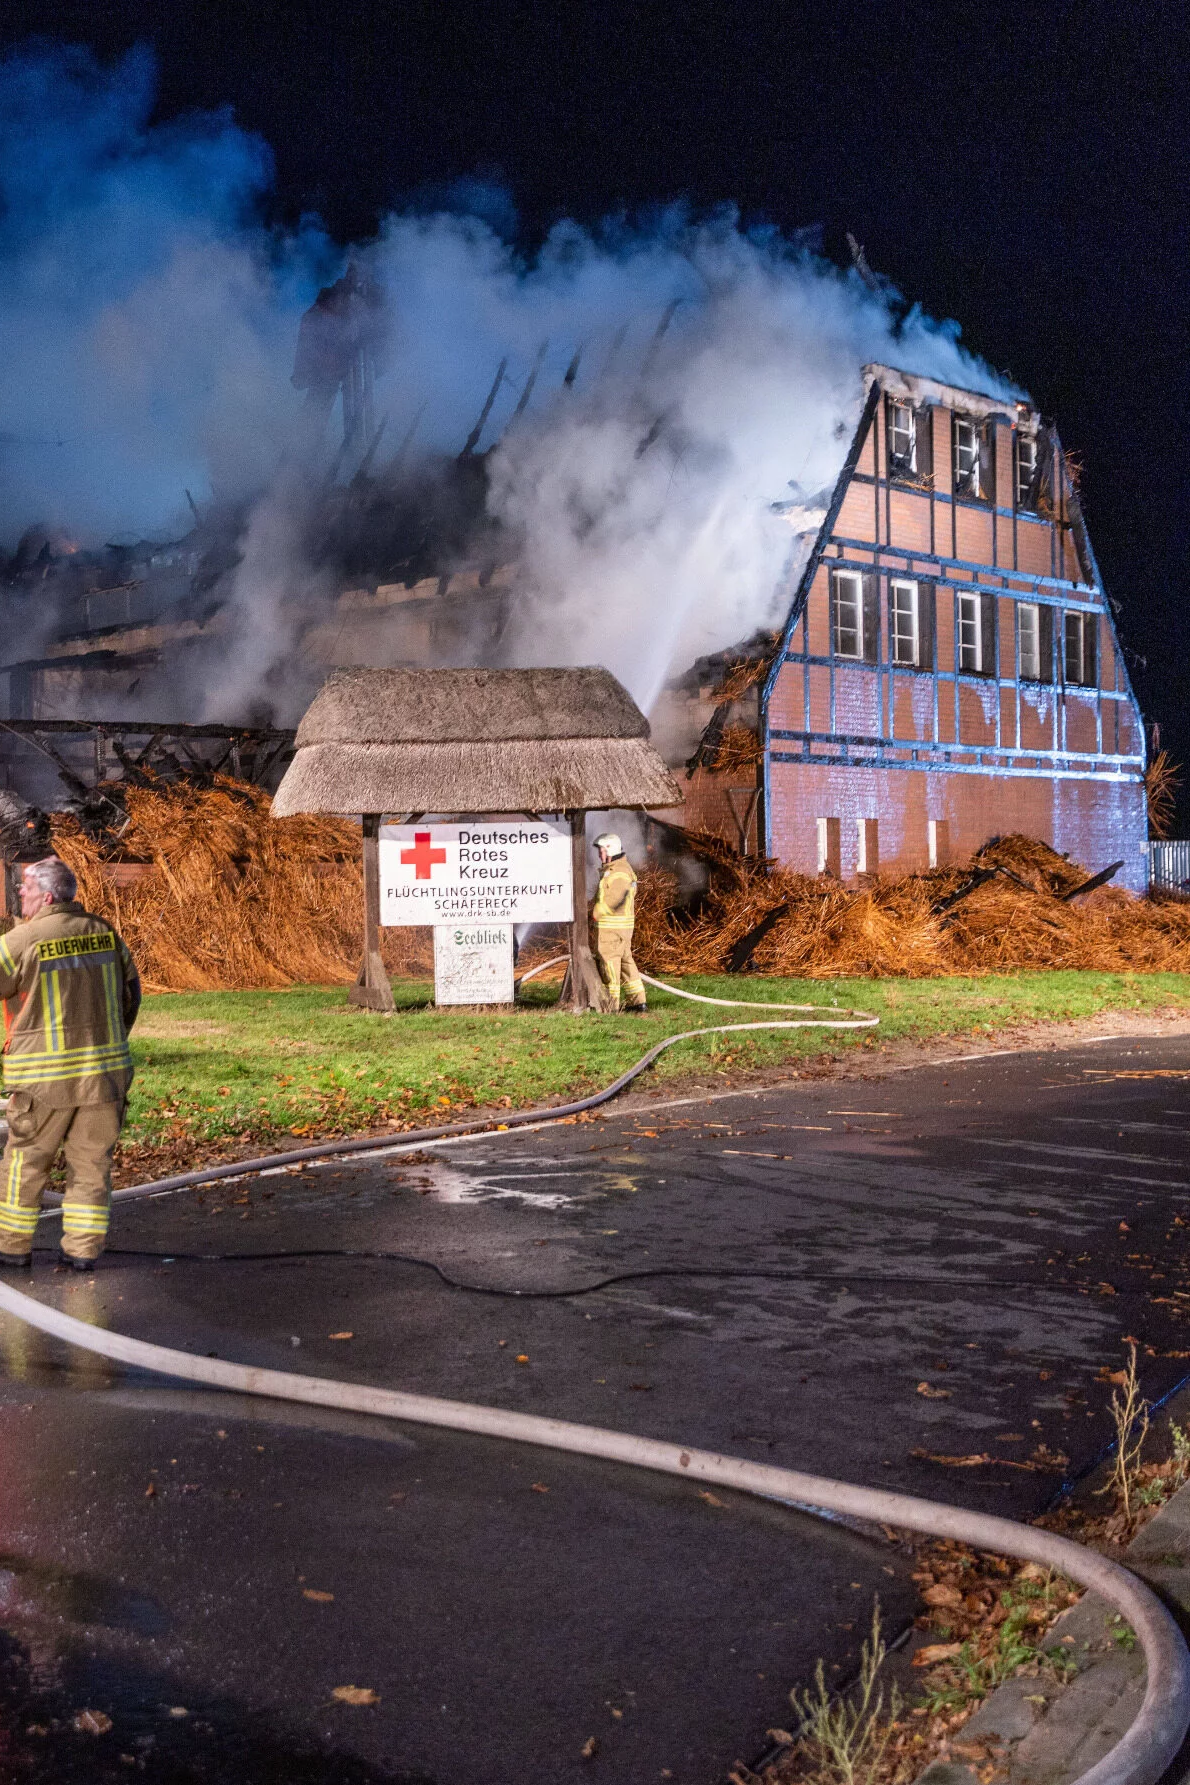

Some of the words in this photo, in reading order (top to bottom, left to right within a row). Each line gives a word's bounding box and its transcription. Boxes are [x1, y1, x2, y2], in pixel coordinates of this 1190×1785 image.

[458, 830, 549, 845] Deutsches
[458, 848, 509, 862] Rotes
[458, 866, 509, 879] Kreuz
[387, 884, 564, 898] FLÜCHTLINGSUNTERKUNFT
[453, 929, 507, 946] Seeblick
[39, 934, 112, 960] FEUERWEHR
